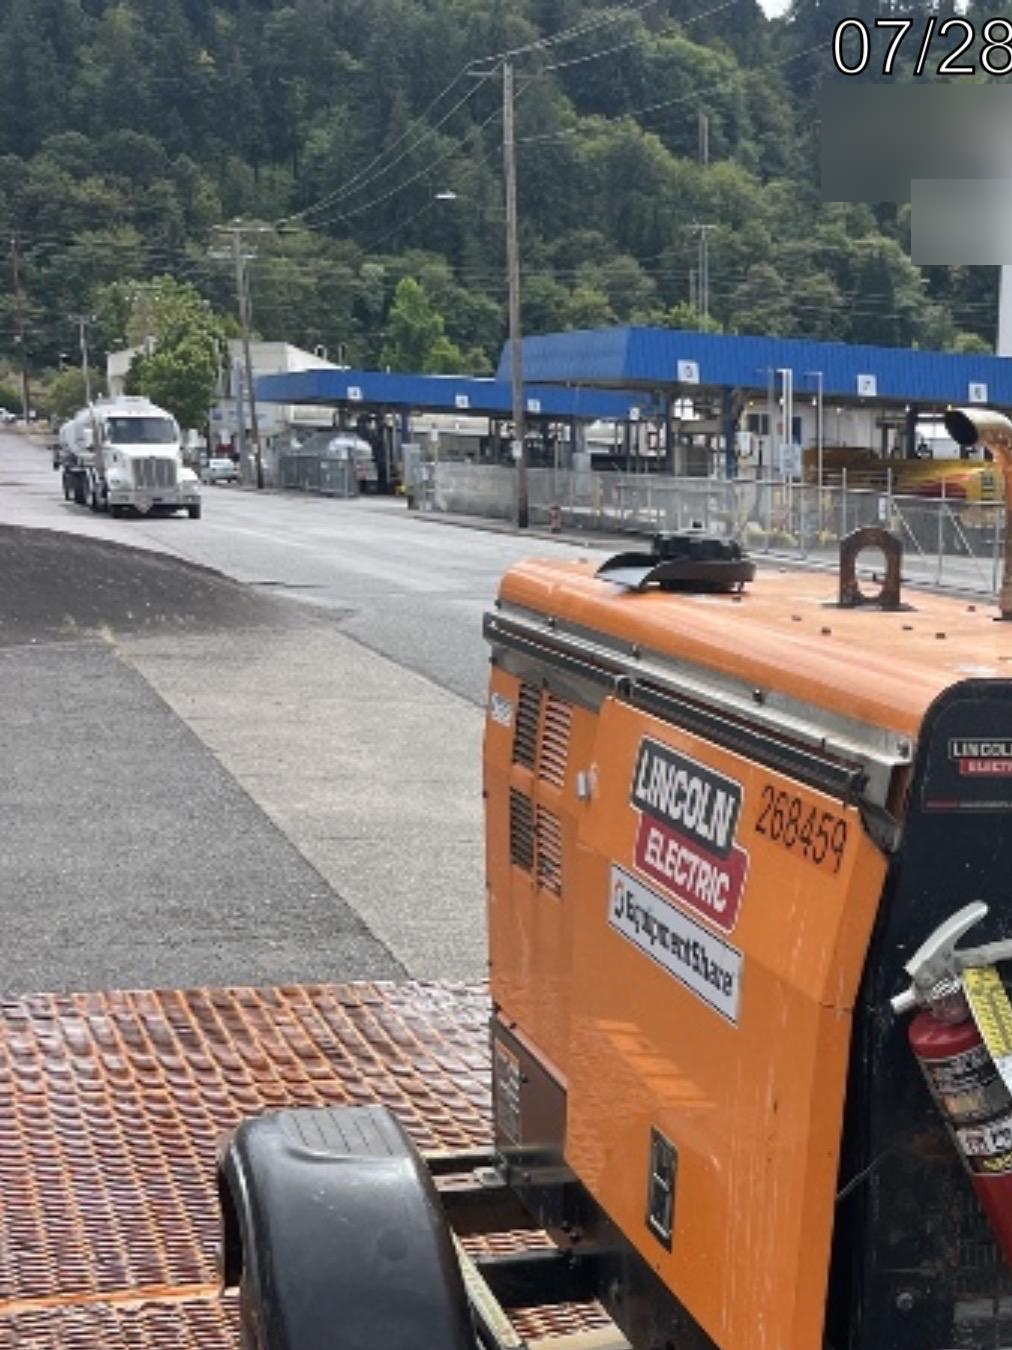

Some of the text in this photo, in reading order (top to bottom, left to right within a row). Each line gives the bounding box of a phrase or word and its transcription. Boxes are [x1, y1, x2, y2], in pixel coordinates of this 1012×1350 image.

[635, 750, 736, 848] LINCOLN
[754, 785, 848, 875] 268459
[644, 827, 731, 914] ELECTRIC
